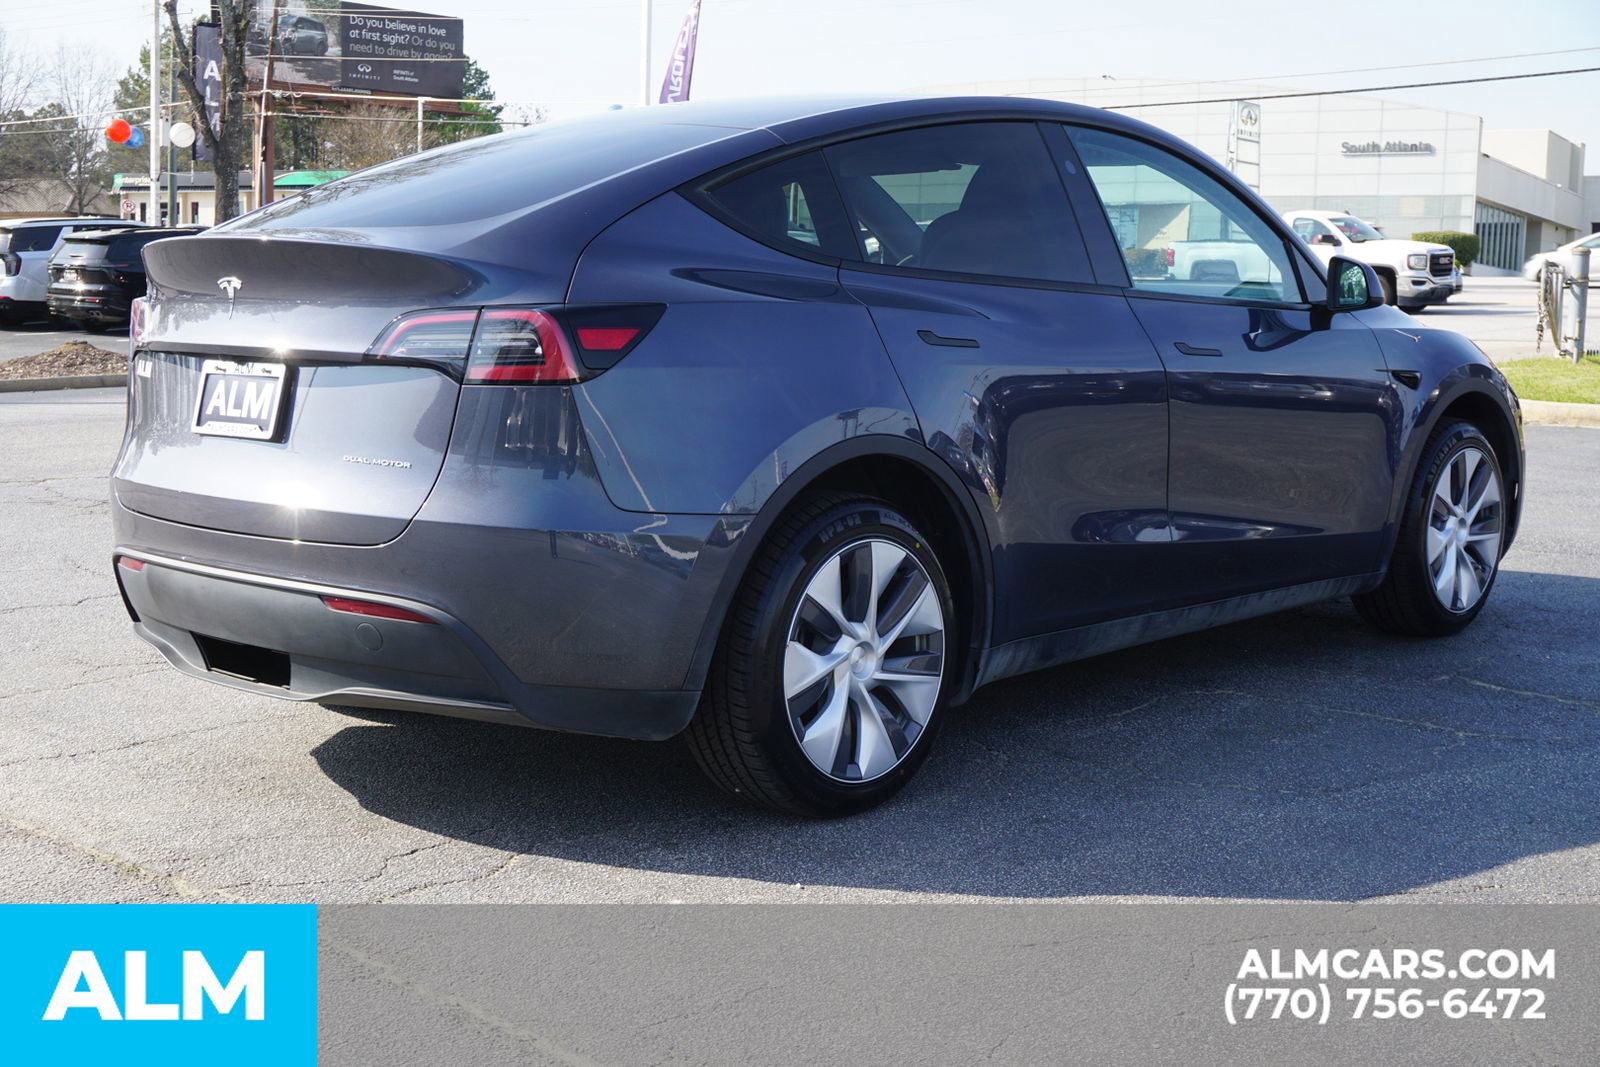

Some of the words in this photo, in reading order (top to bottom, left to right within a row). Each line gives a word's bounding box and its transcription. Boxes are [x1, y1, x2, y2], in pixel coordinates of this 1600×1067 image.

[349, 15, 364, 25] Do
[365, 19, 383, 29] you
[385, 18, 416, 32] believe
[418, 22, 426, 34] in
[428, 24, 447, 37] love
[349, 29, 360, 39] at
[361, 29, 381, 41] first
[382, 31, 410, 46] sight?
[411, 35, 424, 46] Or
[425, 37, 437, 48] do
[439, 41, 456, 51] you
[349, 42, 373, 54] need
[375, 44, 385, 54] to
[386, 46, 410, 58] drive
[410, 49, 422, 62] by
[348, 73, 381, 81] INFINITI
[1341, 140, 1381, 154] South
[1383, 140, 1433, 154] Atlanta
[205, 379, 275, 420] ALM
[343, 454, 371, 465] DUAL
[373, 458, 412, 469] MOTOR
